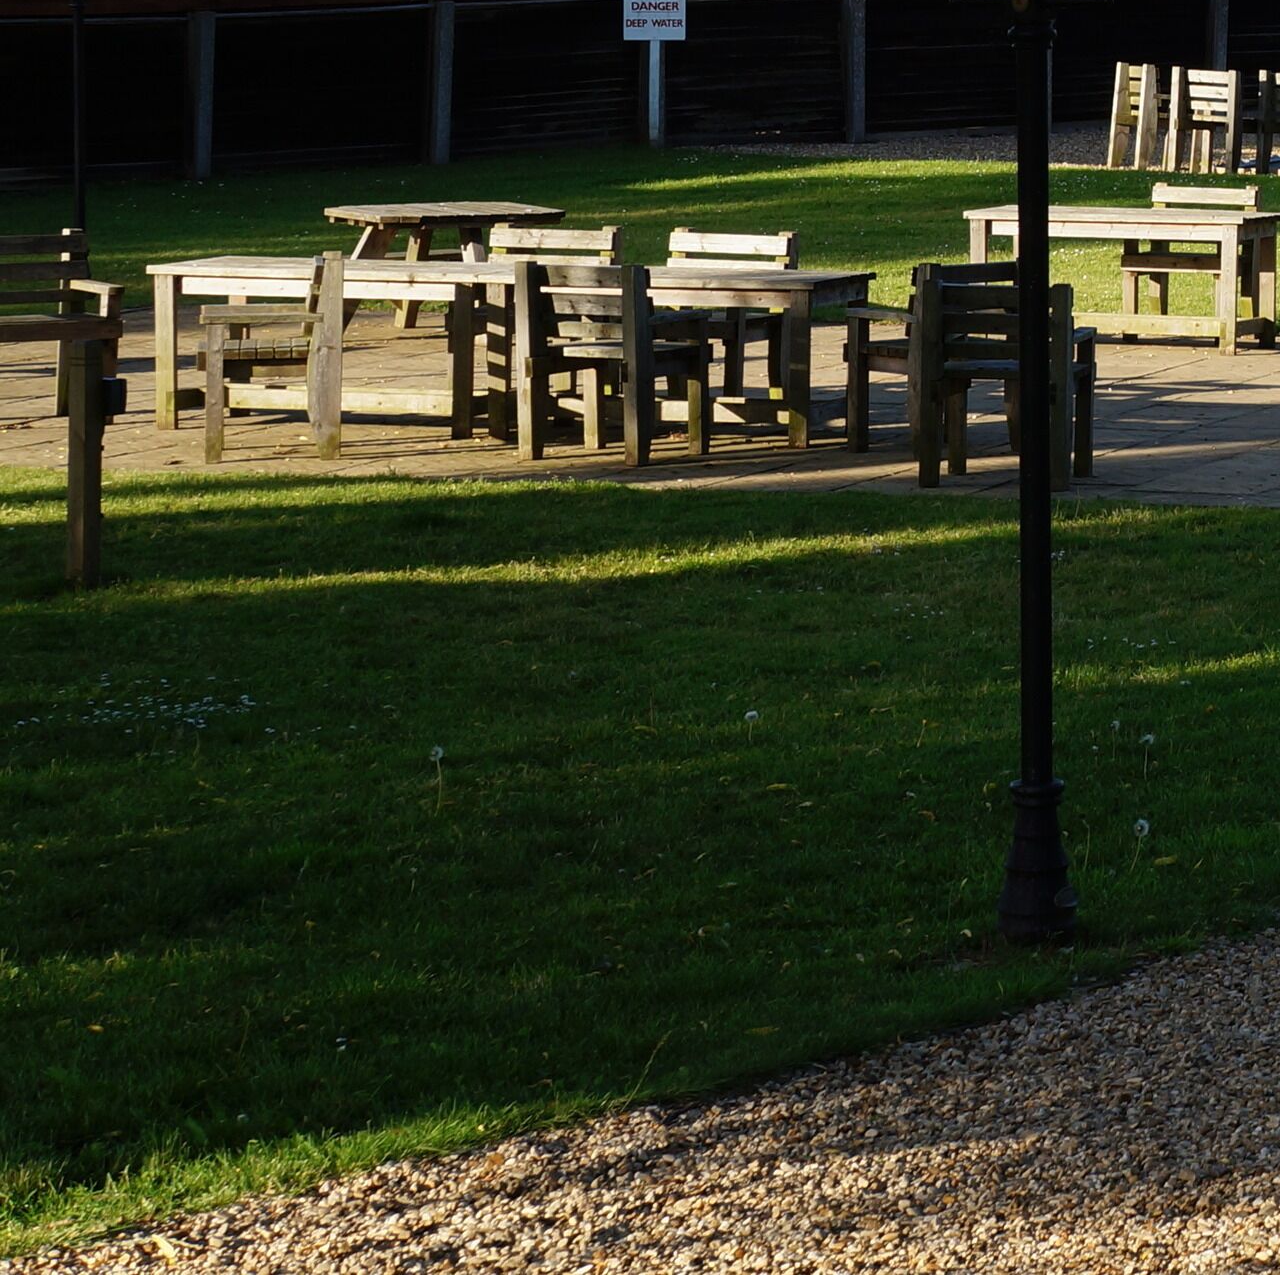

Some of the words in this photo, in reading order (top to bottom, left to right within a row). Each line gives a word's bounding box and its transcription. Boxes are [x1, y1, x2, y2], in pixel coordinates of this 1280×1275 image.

[631, 2, 679, 11] DANGER
[626, 19, 647, 27] DEEP
[651, 19, 683, 27] WATER
